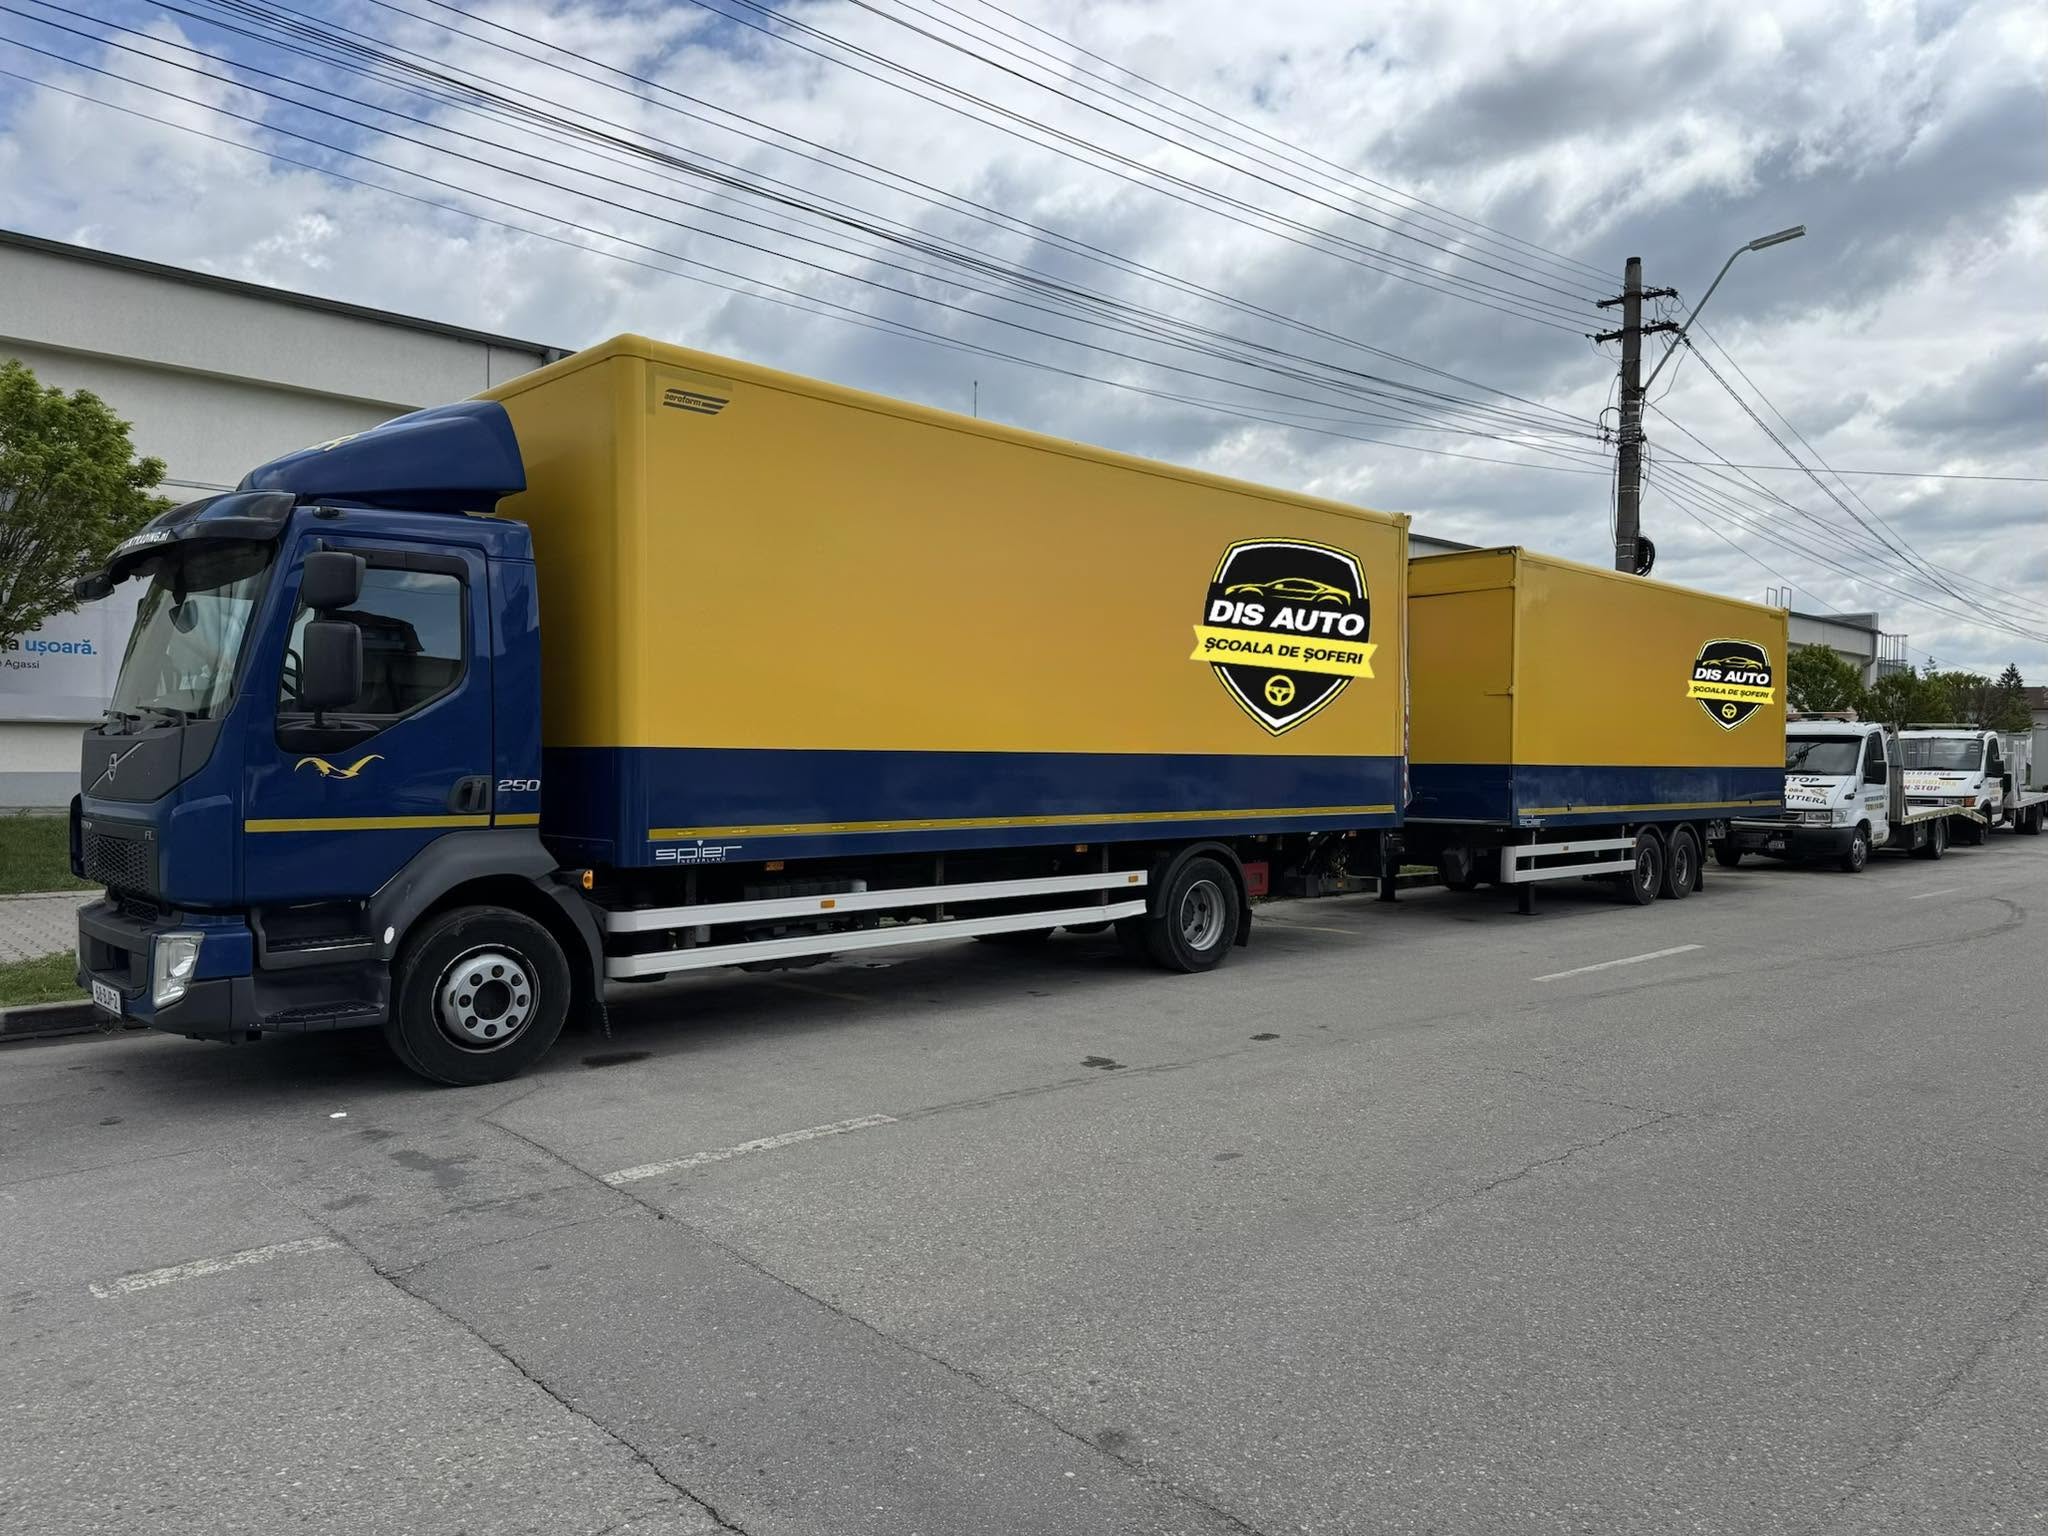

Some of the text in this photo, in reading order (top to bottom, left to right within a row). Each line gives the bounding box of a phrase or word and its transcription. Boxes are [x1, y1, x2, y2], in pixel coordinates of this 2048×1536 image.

[1208, 599, 1365, 637] DIS AUTO
[25, 638, 97, 656] ușoară.
[1204, 637, 1364, 665] ȘCOALA DE ȘOFERI
[5, 659, 40, 670] Agassi
[1694, 668, 1769, 685] DIS AUTO
[1727, 688, 1739, 696] DE
[497, 779, 542, 792] 250
[655, 840, 743, 864] spier
